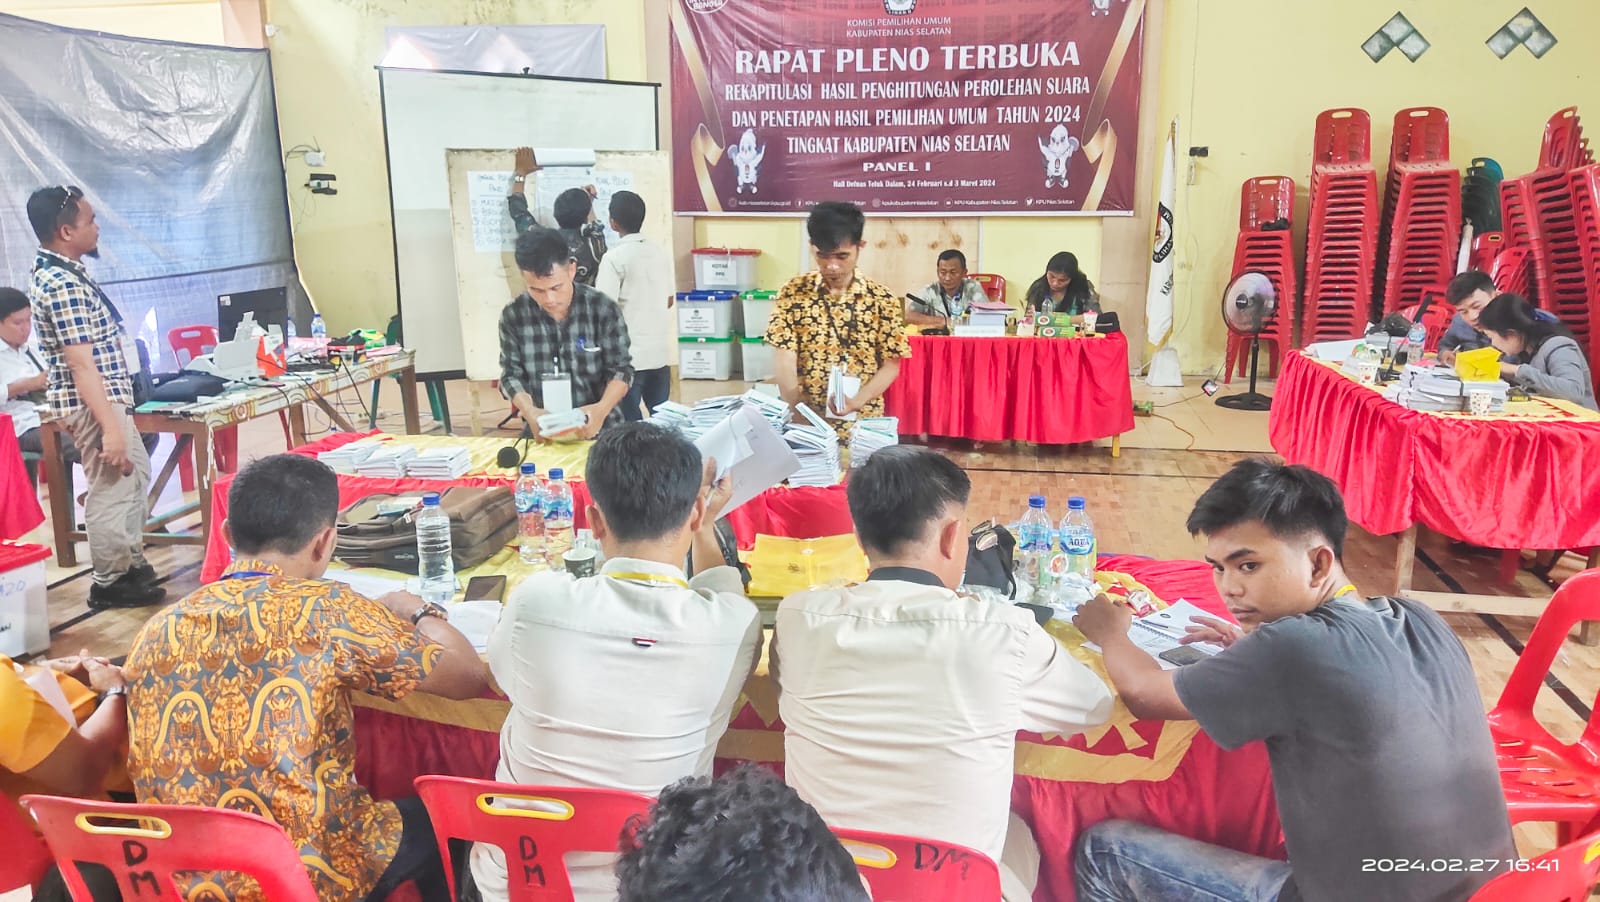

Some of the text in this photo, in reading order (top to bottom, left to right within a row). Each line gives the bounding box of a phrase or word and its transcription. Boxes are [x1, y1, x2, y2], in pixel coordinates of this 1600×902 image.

[846, 27, 951, 37] KABUPATEN NIAS SELATAN
[847, 17, 951, 27] KOMISI PEMILIHAN UMUM
[735, 41, 1081, 74] RAPAT PLENO TERBUKA
[725, 76, 1090, 101] REKAPITULASI HASIL PENGHITUNGAN PEROLEHAN SUARA
[732, 105, 1080, 128] DAN PENETAPAN HASIL PEMILIHAN UMUM TAHUN 2024
[787, 134, 1011, 154] TINGKAT KABUPATEN NIAS SELATAN
[863, 161, 931, 172] PANEL I
[907, 180, 915, 188] 24
[917, 180, 942, 188] Februari
[979, 179, 996, 187] 2024
[1068, 538, 1090, 547] AQUA
[122, 840, 148, 867] D
[519, 835, 537, 861] D
[129, 870, 161, 896] M
[523, 863, 545, 888] M
